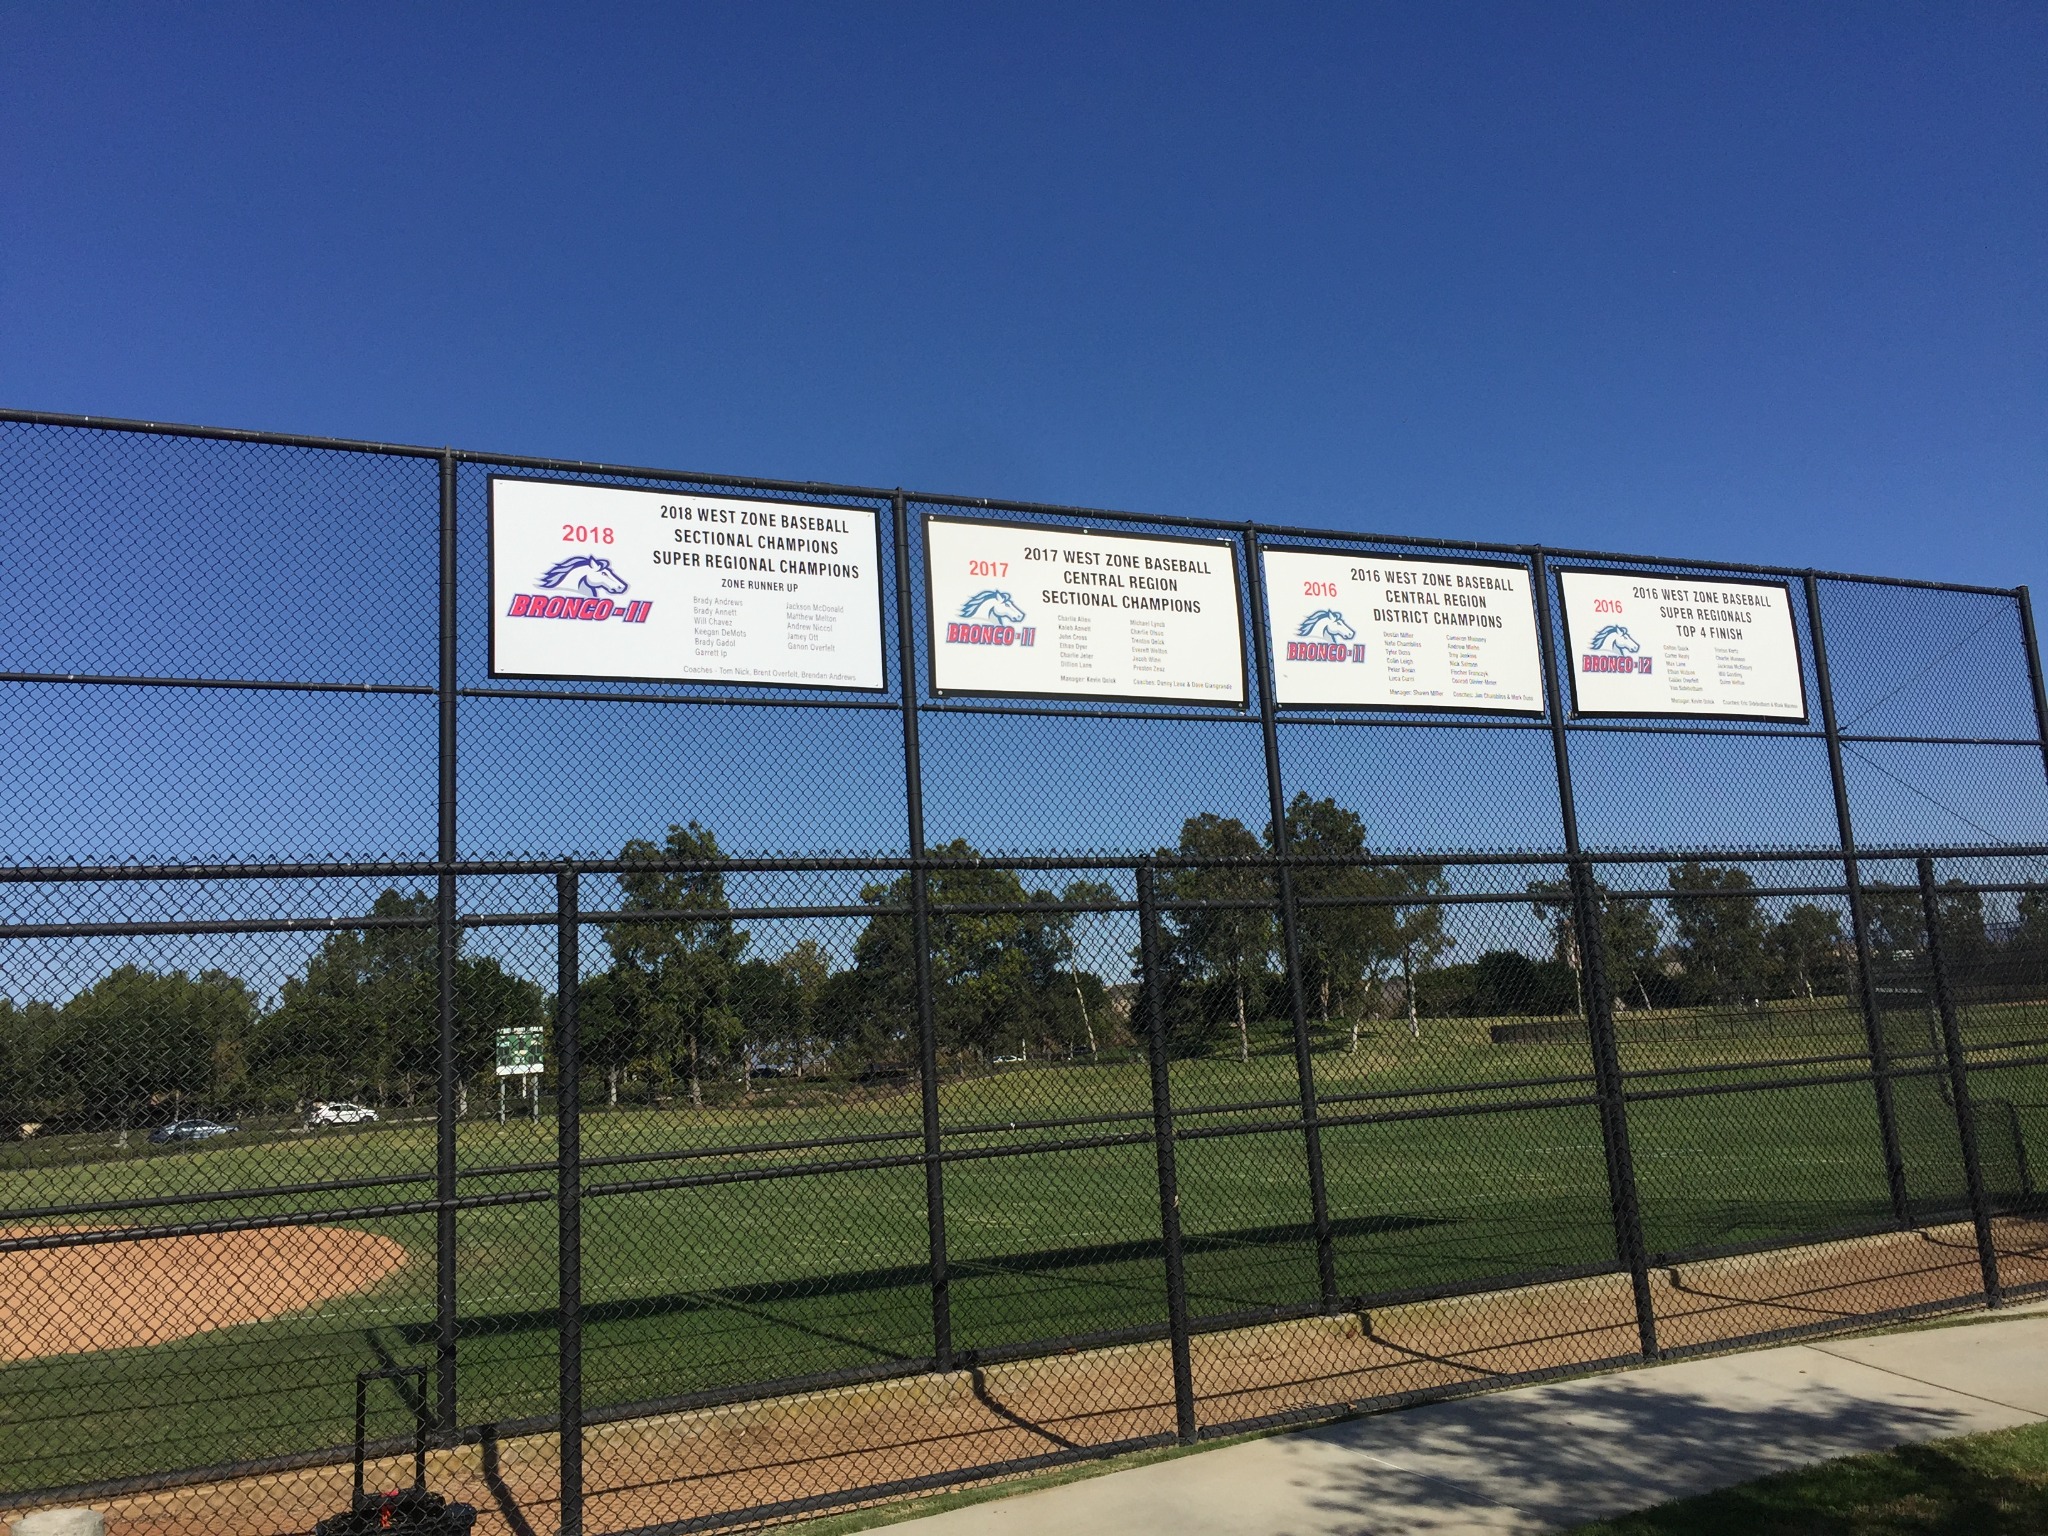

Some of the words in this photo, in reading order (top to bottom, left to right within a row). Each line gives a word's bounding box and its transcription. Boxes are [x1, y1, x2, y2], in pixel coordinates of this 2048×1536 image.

[660, 505, 693, 521] 2018
[698, 507, 736, 524] WEST
[741, 511, 776, 528] ZONE
[781, 514, 849, 534] BASEBALL
[562, 524, 614, 545] 2018
[674, 529, 753, 548] SECTIONAL
[758, 534, 838, 555] CHAMPIONS
[653, 550, 700, 568] SUPER
[705, 554, 775, 573] REGIONAL
[780, 559, 860, 579] CHAMPIONS
[1024, 547, 1058, 562] 2017
[1063, 550, 1100, 565] WEST
[1106, 554, 1141, 568] ZONE
[1145, 557, 1211, 574] BASEBALL
[969, 560, 1009, 578] 2017
[722, 578, 745, 589] ZONE
[748, 580, 784, 591] RUNNER
[786, 582, 799, 593] UP
[1064, 570, 1125, 588] CENTRAL
[1129, 575, 1178, 592] REGION
[1350, 568, 1380, 582] 2016
[1384, 571, 1417, 584] WEST
[1422, 574, 1453, 587] ZONE
[1456, 576, 1514, 592] BASEBALL
[1304, 582, 1337, 597] 2016
[1633, 587, 1658, 600] 2016
[1662, 589, 1689, 602] WEST
[1694, 591, 1720, 604] ZONE
[1723, 593, 1772, 608] BASEBALL
[693, 596, 712, 606] Brady
[715, 598, 743, 606] Andrews
[1042, 590, 1118, 608] SECTIONAL
[1122, 596, 1201, 614] CHAMPIONS
[1386, 590, 1440, 606] CENTRAL
[1445, 594, 1487, 608] REGION
[1594, 599, 1623, 614] 2016
[694, 607, 712, 616] Brady
[786, 602, 811, 610] Jackson
[813, 604, 844, 613] McDonald
[1660, 606, 1694, 620] SUPER
[1697, 610, 1752, 623] REGIONALS
[709, 618, 732, 626] Chavez
[787, 612, 813, 621] Matthew
[1373, 608, 1428, 624] DISTRICT
[1434, 612, 1503, 629] CHAMPIONS
[694, 628, 719, 637] Keegan
[722, 629, 746, 637] DeMots
[787, 633, 807, 642] Jamey
[1676, 625, 1696, 637] TOP
[1701, 627, 1706, 638] 4
[1710, 628, 1743, 640] FINISH
[695, 638, 714, 647] Brady
[695, 648, 719, 656] Garrett
[1582, 655, 1652, 674] BRONCO-12
[683, 666, 713, 674] Coaches
[802, 671, 828, 679] Brendan
[829, 673, 856, 681] Andrews
